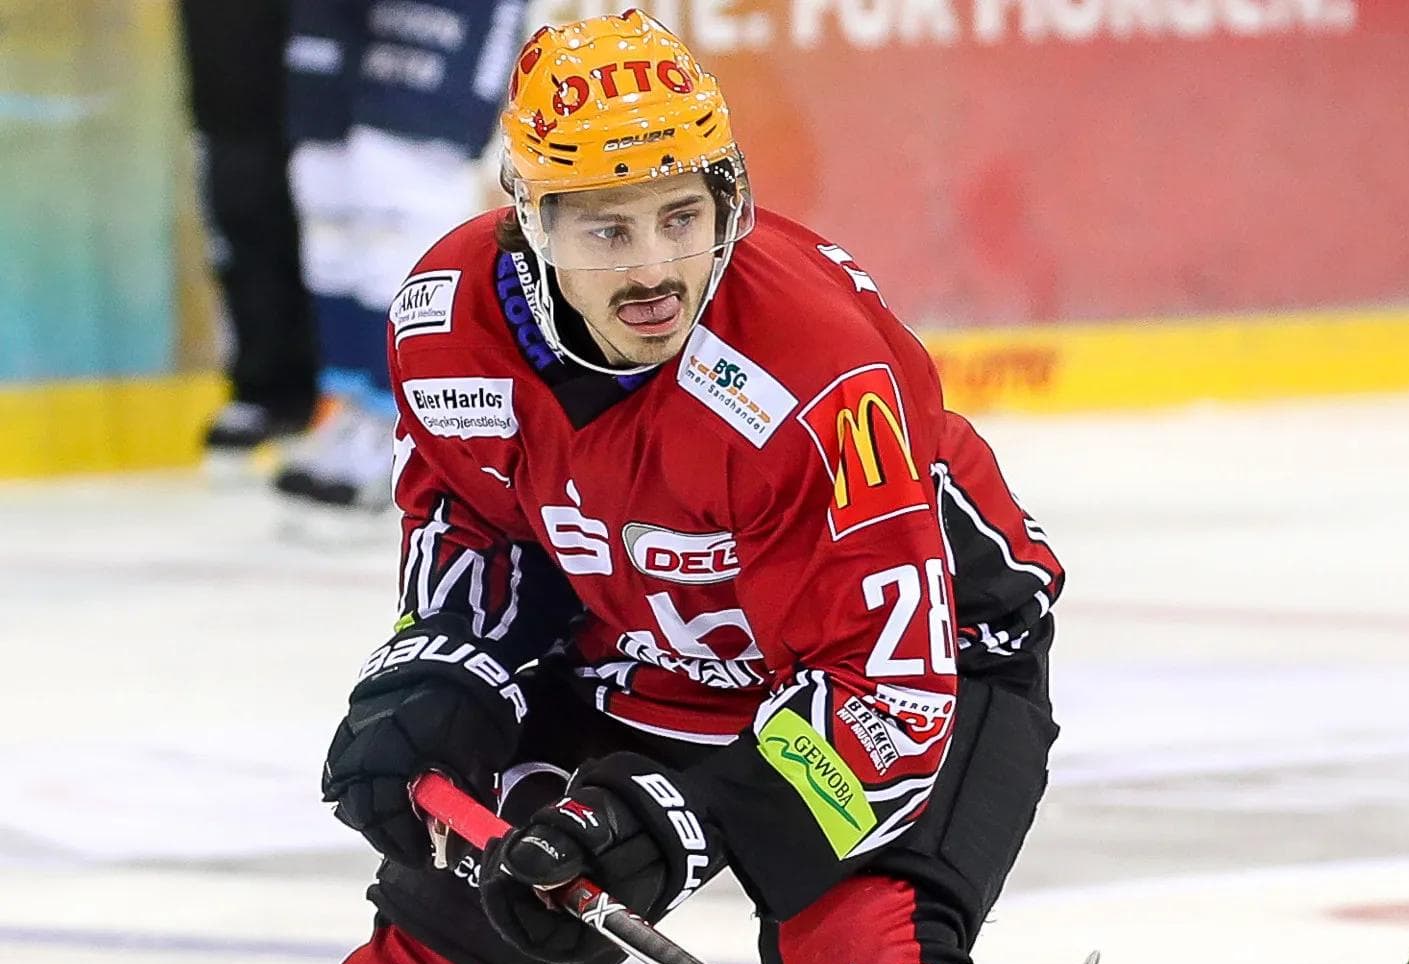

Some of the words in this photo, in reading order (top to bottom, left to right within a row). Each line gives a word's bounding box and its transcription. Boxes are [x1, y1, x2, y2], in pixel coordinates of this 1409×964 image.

[712, 357, 748, 391] BSG
[412, 389, 440, 410] Bier
[794, 734, 854, 808] GEWOBA
